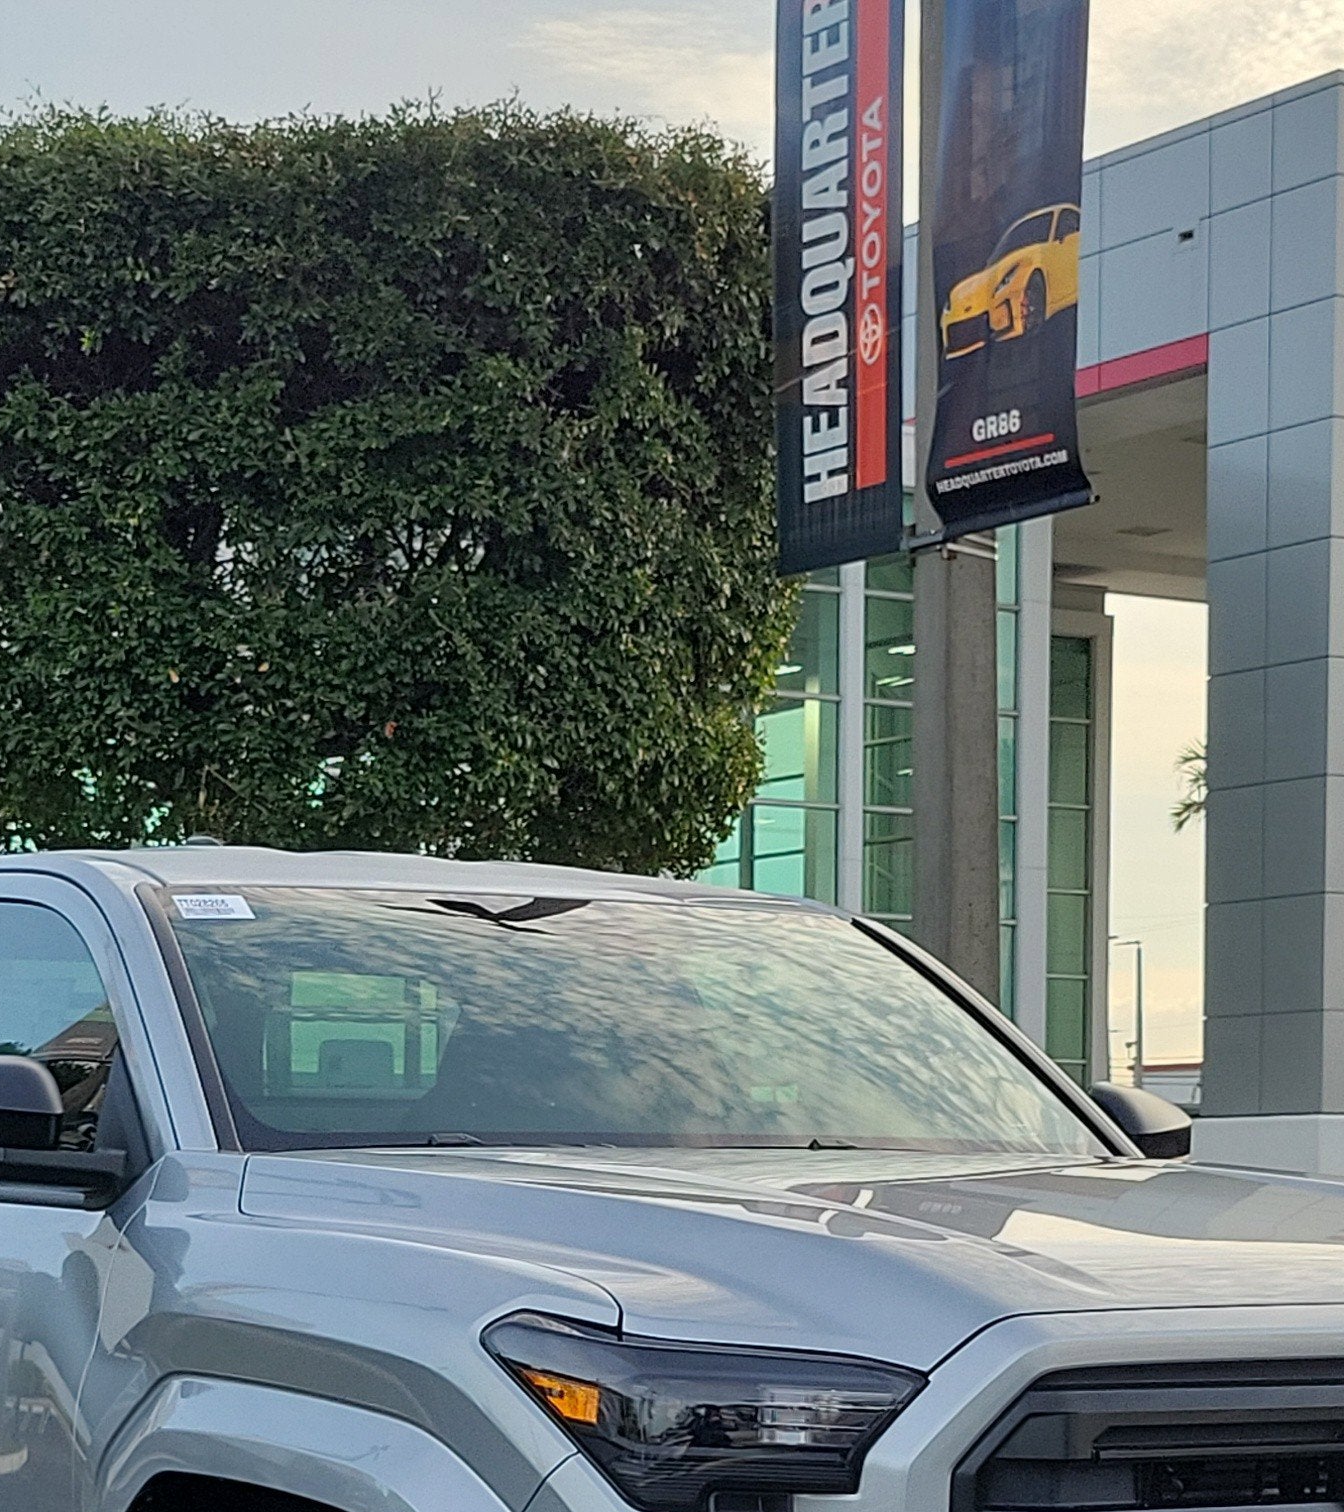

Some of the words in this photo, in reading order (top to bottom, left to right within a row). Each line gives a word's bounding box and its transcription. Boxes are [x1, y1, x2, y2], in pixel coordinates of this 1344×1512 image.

[801, 0, 855, 504] HEADQUARTER
[861, 96, 884, 300] TOYOTA
[935, 449, 1069, 494] HEADQUARTERTOYOTA.COM
[971, 409, 1022, 442] GR86
